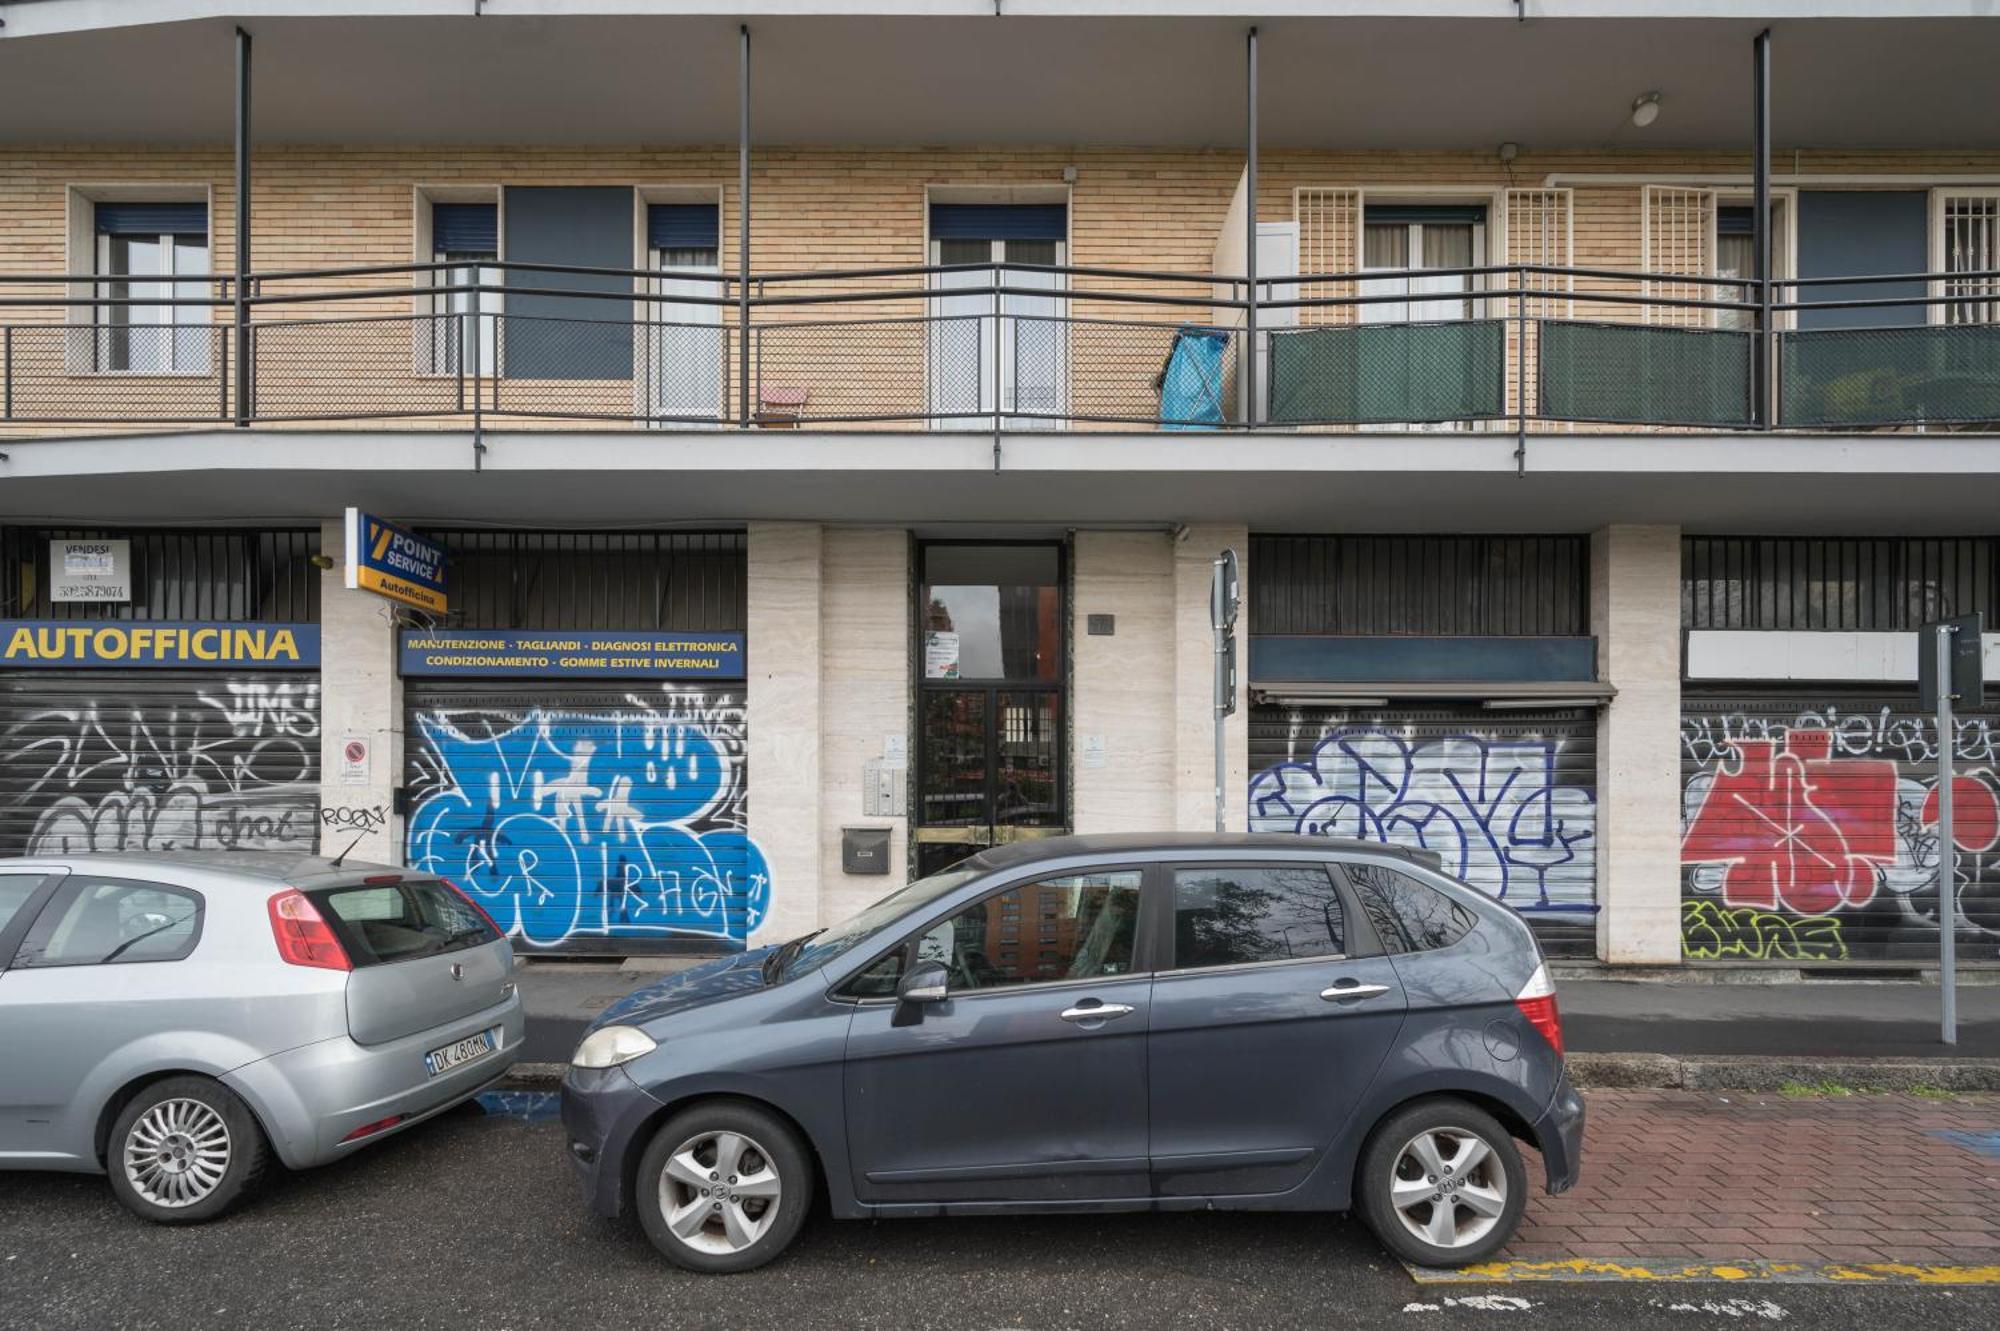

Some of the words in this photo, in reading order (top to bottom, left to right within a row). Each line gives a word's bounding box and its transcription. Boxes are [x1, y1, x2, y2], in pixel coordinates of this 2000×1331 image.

[65, 544, 110, 555] VENDESI
[393, 533, 441, 566] POINT
[387, 551, 433, 580] SERVICE
[380, 579, 434, 605] Autofficina
[4, 627, 300, 661] AUTOFFICINA
[407, 639, 505, 650] MANUTENZIONE
[516, 640, 581, 651] TAGLIANDI
[591, 641, 651, 651] DIAGNOSI
[654, 642, 737, 652] ELETTRONICA
[426, 655, 549, 667] CONDIZIONAMENTO
[559, 658, 607, 668] GOMME
[610, 658, 651, 668] ESTIVE
[654, 658, 720, 669] INVERNALI
[434, 1049, 452, 1071] DK
